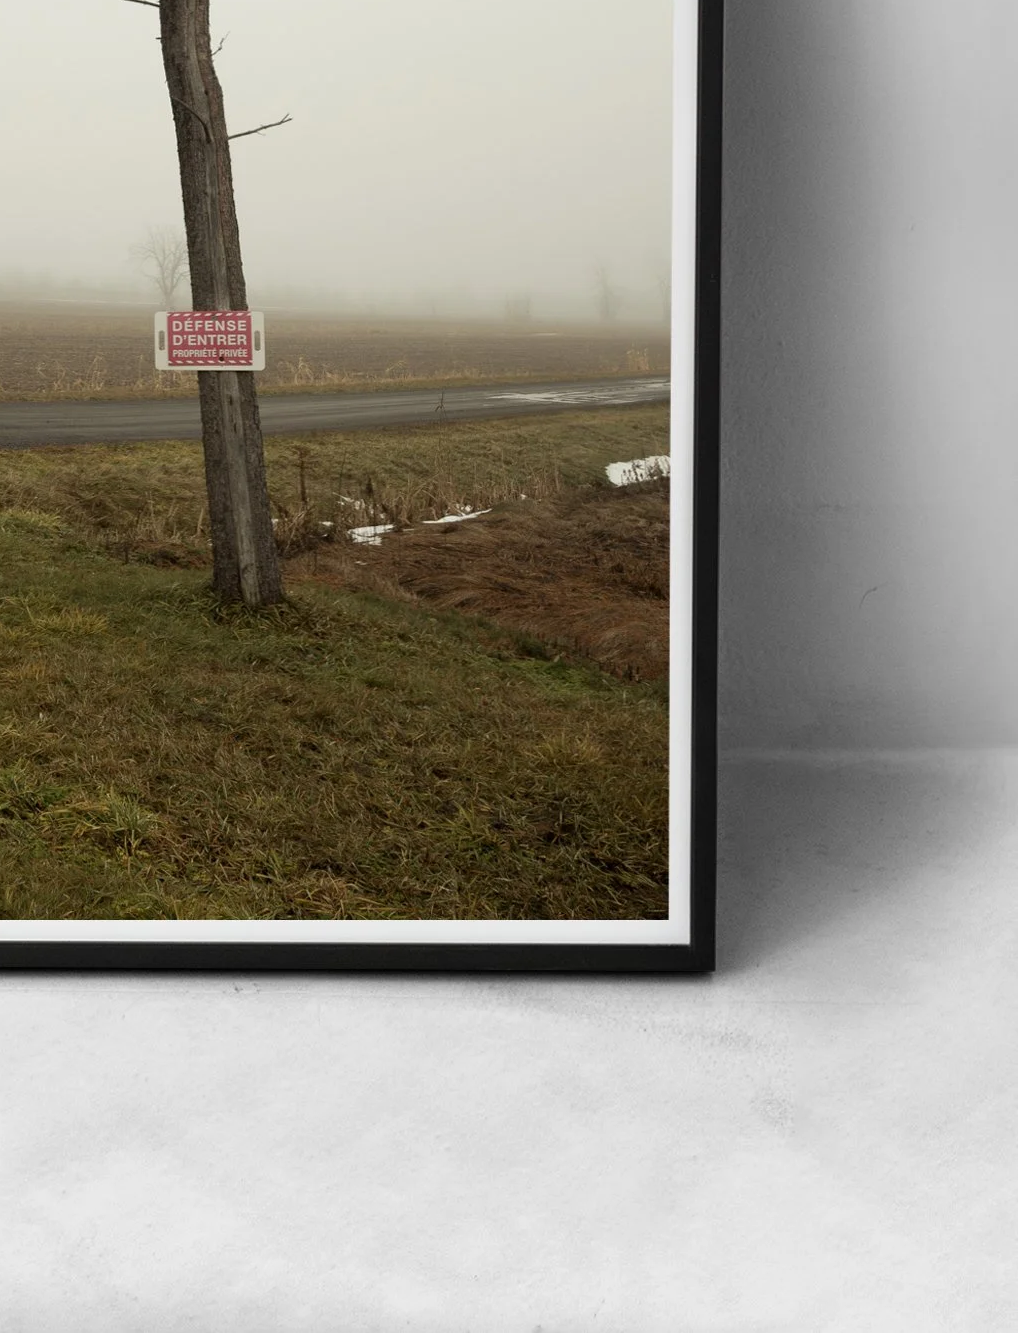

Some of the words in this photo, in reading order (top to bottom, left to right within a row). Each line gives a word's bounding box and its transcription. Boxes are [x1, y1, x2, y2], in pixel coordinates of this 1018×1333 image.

[172, 318, 247, 332] DÉFENSE
[172, 334, 247, 346] D'ENTRER
[172, 348, 217, 357] PROPRIÉTÉ
[219, 348, 248, 357] PRIVÉE
